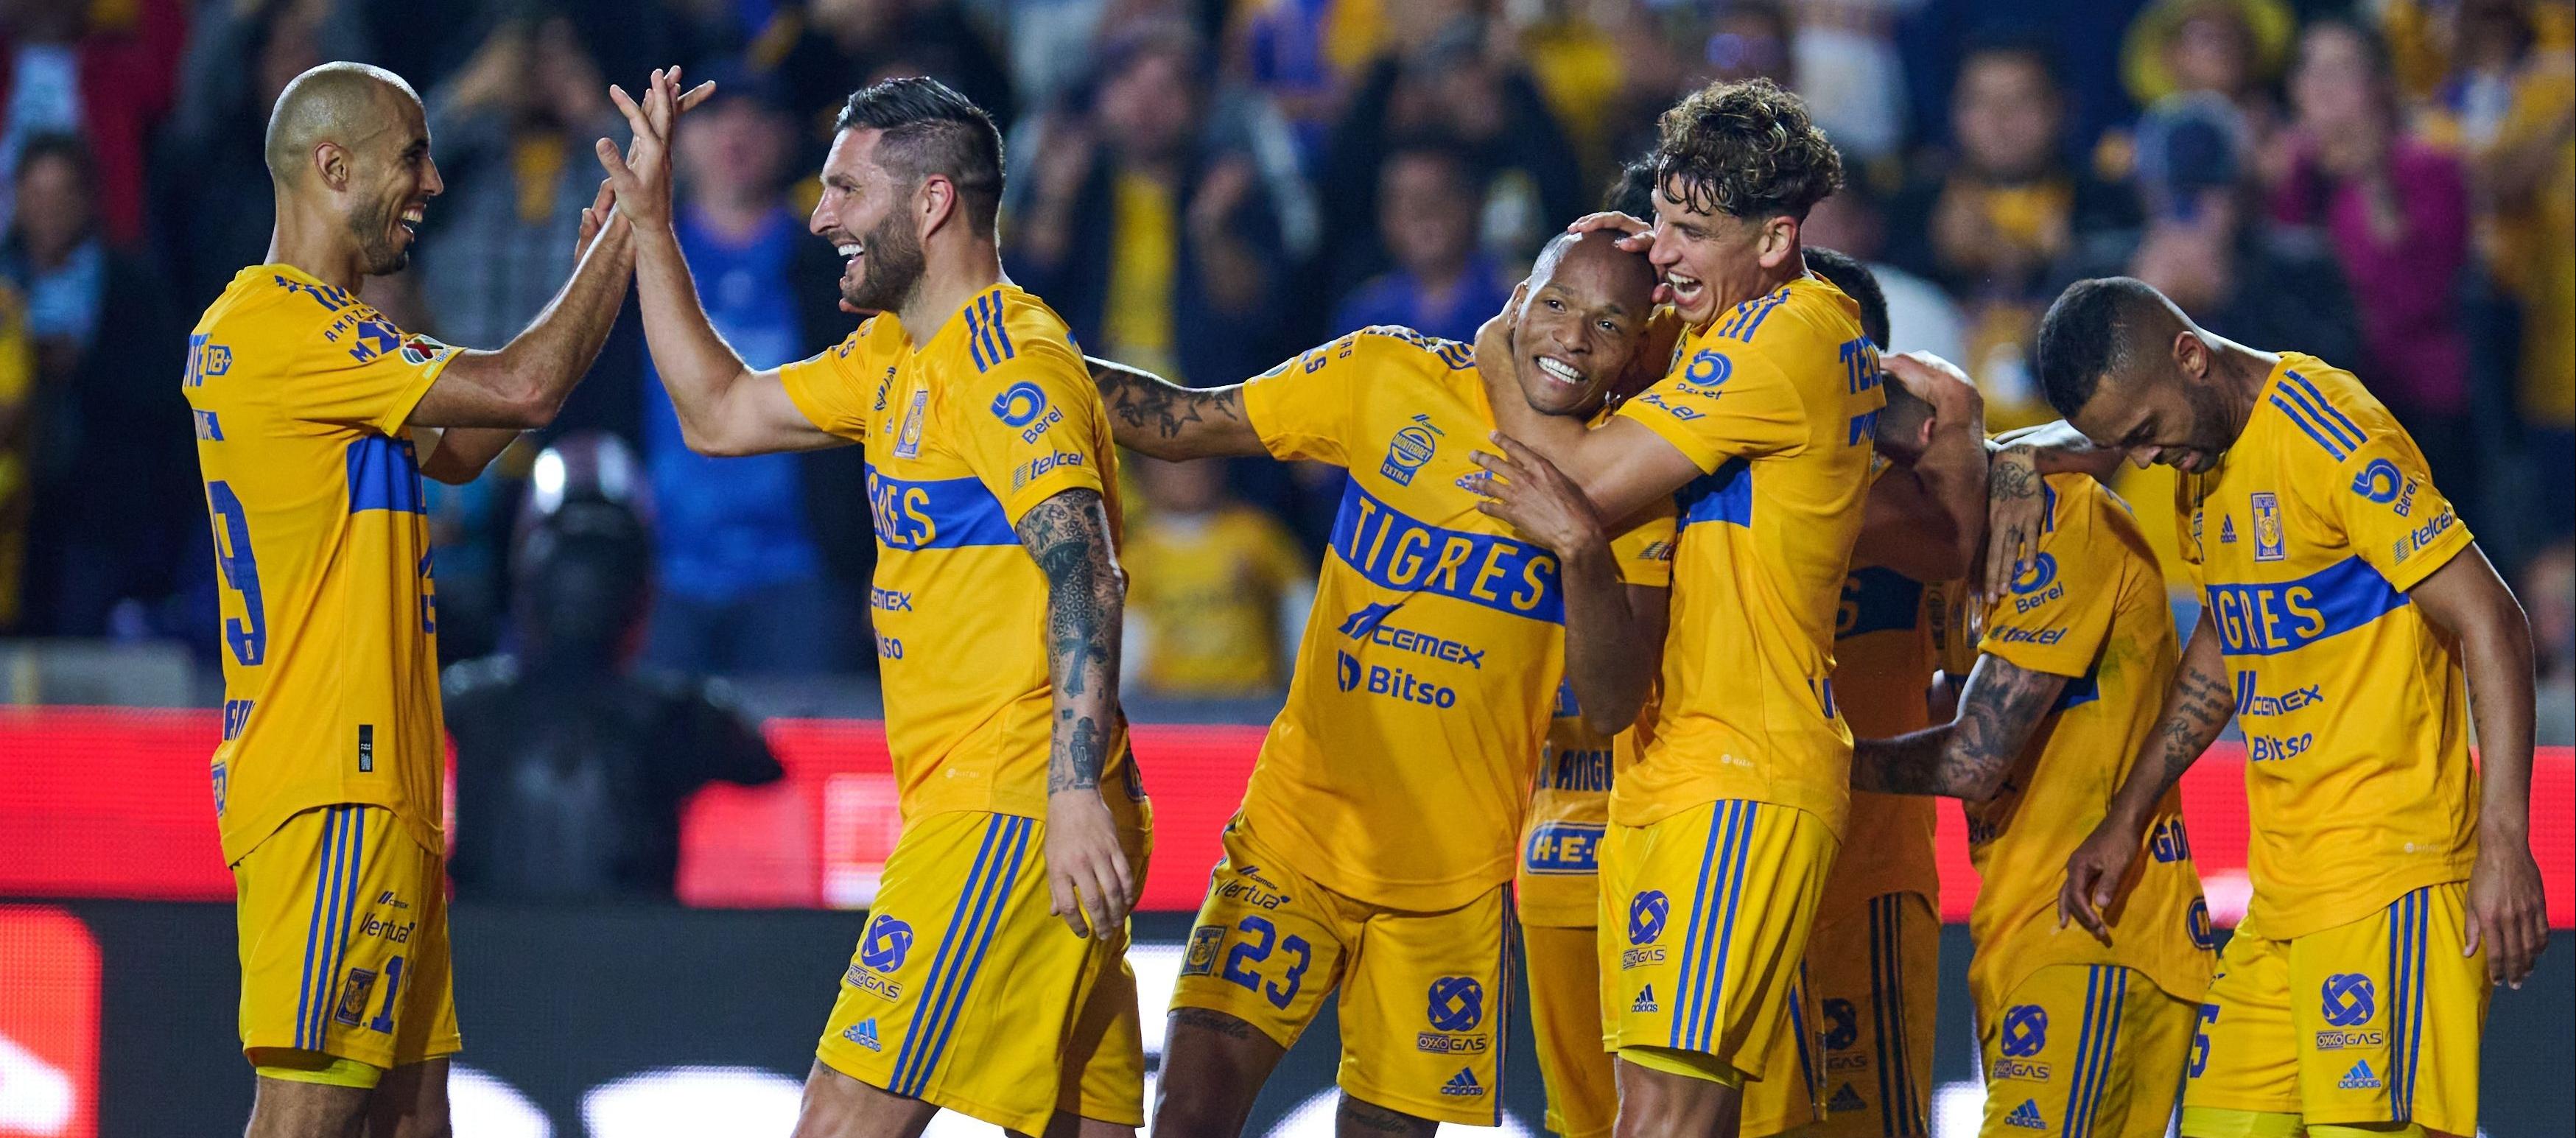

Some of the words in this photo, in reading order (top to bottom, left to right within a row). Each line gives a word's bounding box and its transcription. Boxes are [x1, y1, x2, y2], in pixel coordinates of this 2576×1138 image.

[1022, 405, 1064, 445] Berel
[1031, 449, 1084, 480] telcel
[1394, 433, 1433, 463] MONTERREY
[1382, 464, 1409, 484] EXTRA
[2393, 476, 2418, 518] Berel
[2411, 505, 2454, 552] telcel
[1350, 496, 1556, 611] TIGRES
[2015, 581, 2064, 614] Berel
[1372, 625, 1485, 670] CEMEX
[1368, 664, 1456, 709] Bitso
[2253, 684, 2324, 717] CEMEX
[2252, 732, 2312, 762] Bitso
[1215, 878, 1280, 910] Vertua
[359, 912, 410, 944] Vertua
[1221, 914, 1311, 1011] 23
